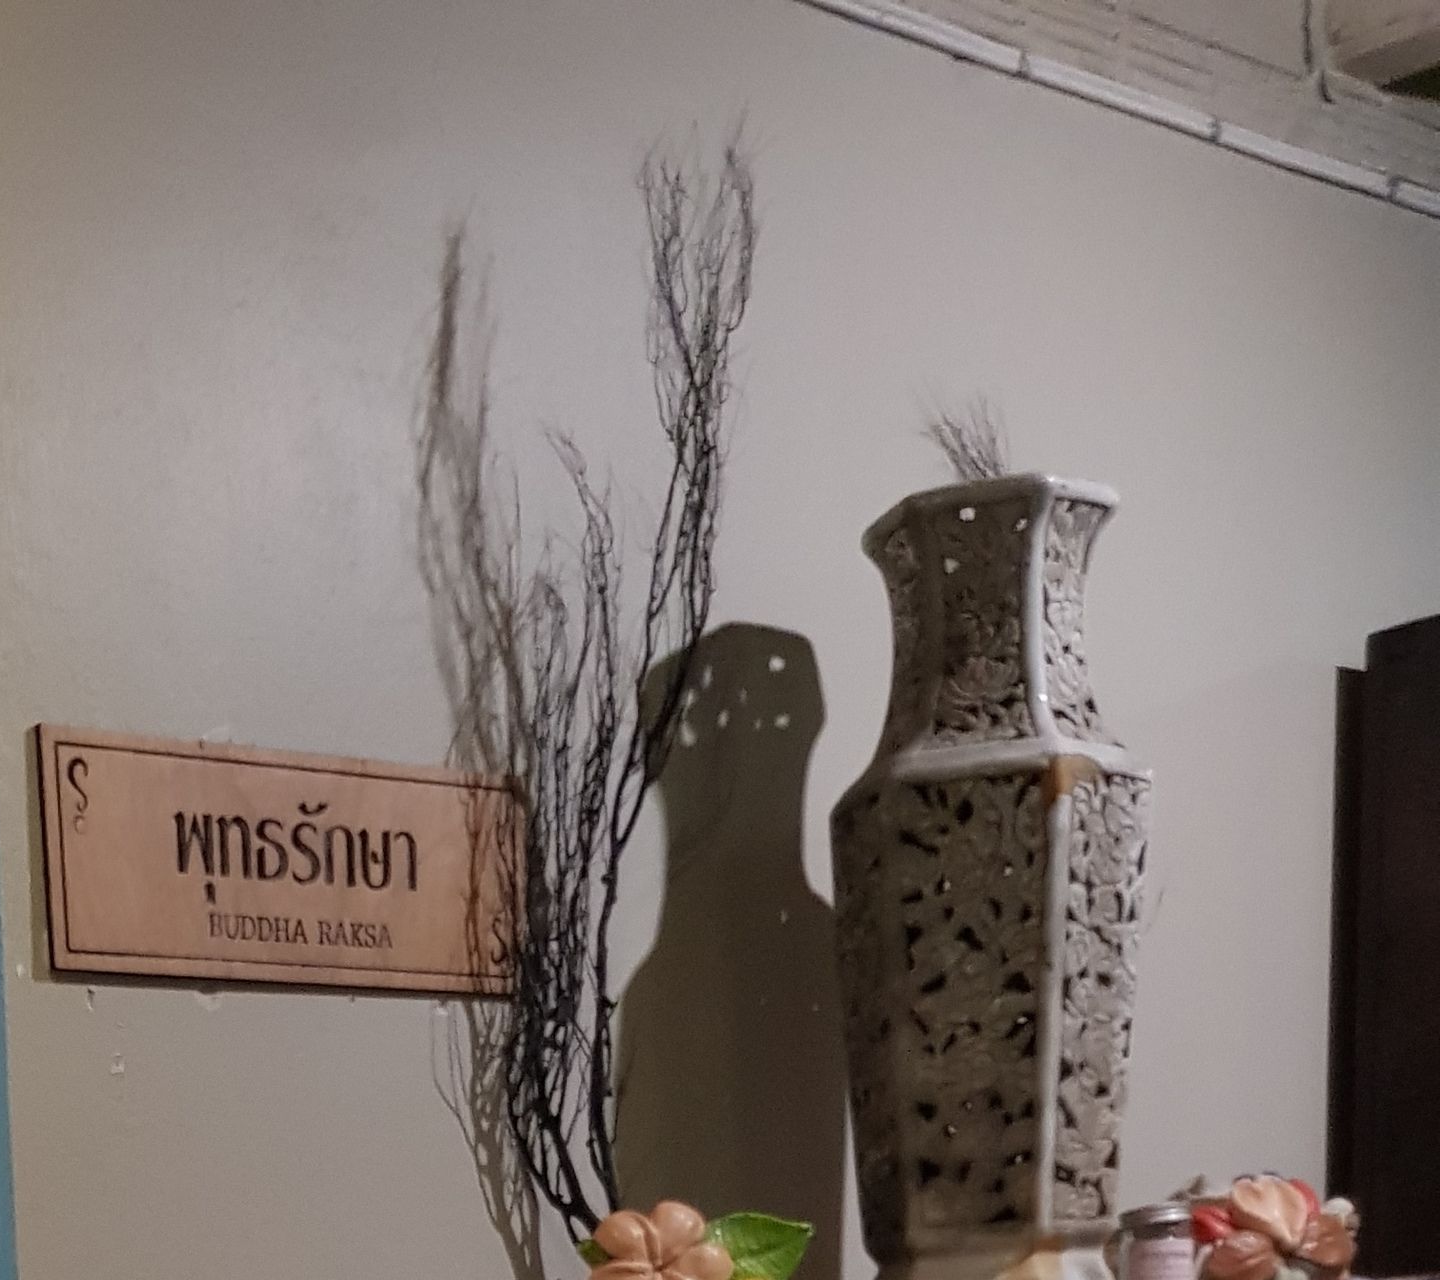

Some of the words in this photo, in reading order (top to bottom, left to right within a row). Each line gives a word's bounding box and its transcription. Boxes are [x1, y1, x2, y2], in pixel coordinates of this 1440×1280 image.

[174, 801, 418, 904] พุทธรักษา
[209, 913, 309, 944] BUDDHA
[317, 920, 394, 949] RAKSA
